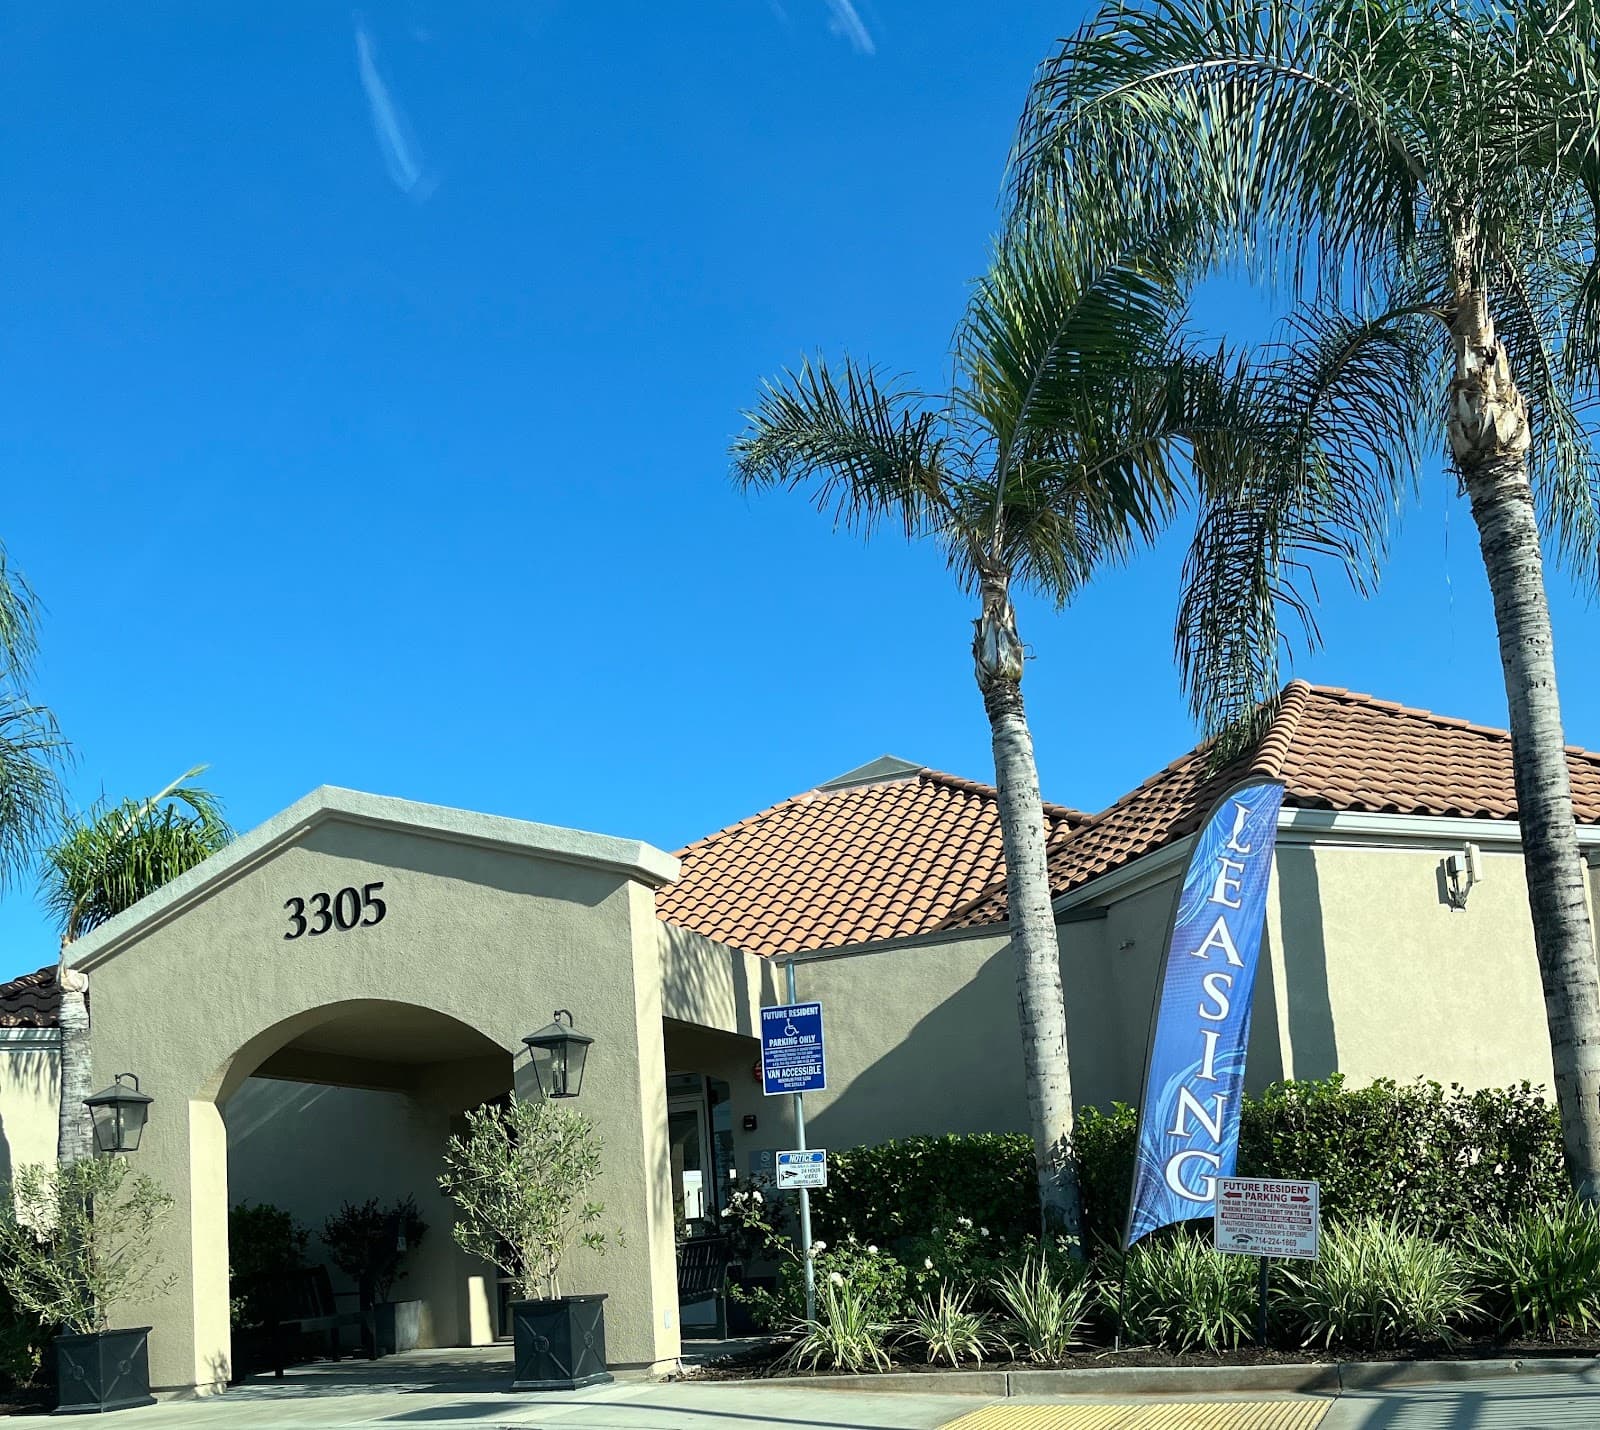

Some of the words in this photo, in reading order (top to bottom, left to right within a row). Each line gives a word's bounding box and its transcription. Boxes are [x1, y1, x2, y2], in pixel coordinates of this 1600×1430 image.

[283, 881, 386, 940] 3305
[1164, 802, 1251, 1202] LEASING
[763, 1010, 787, 1020] FUTURE
[789, 1006, 818, 1018] RESIDENT
[769, 1037, 797, 1047] PARKING
[799, 1034, 815, 1044] ONLY
[767, 1069, 780, 1079] VAN
[782, 1065, 821, 1078] ACCESSIBLE
[789, 1154, 813, 1163] NOTICE
[1224, 1182, 1260, 1191] FUTURE
[1263, 1184, 1310, 1194] RESIDENT
[1245, 1192, 1287, 1202] PARKING
